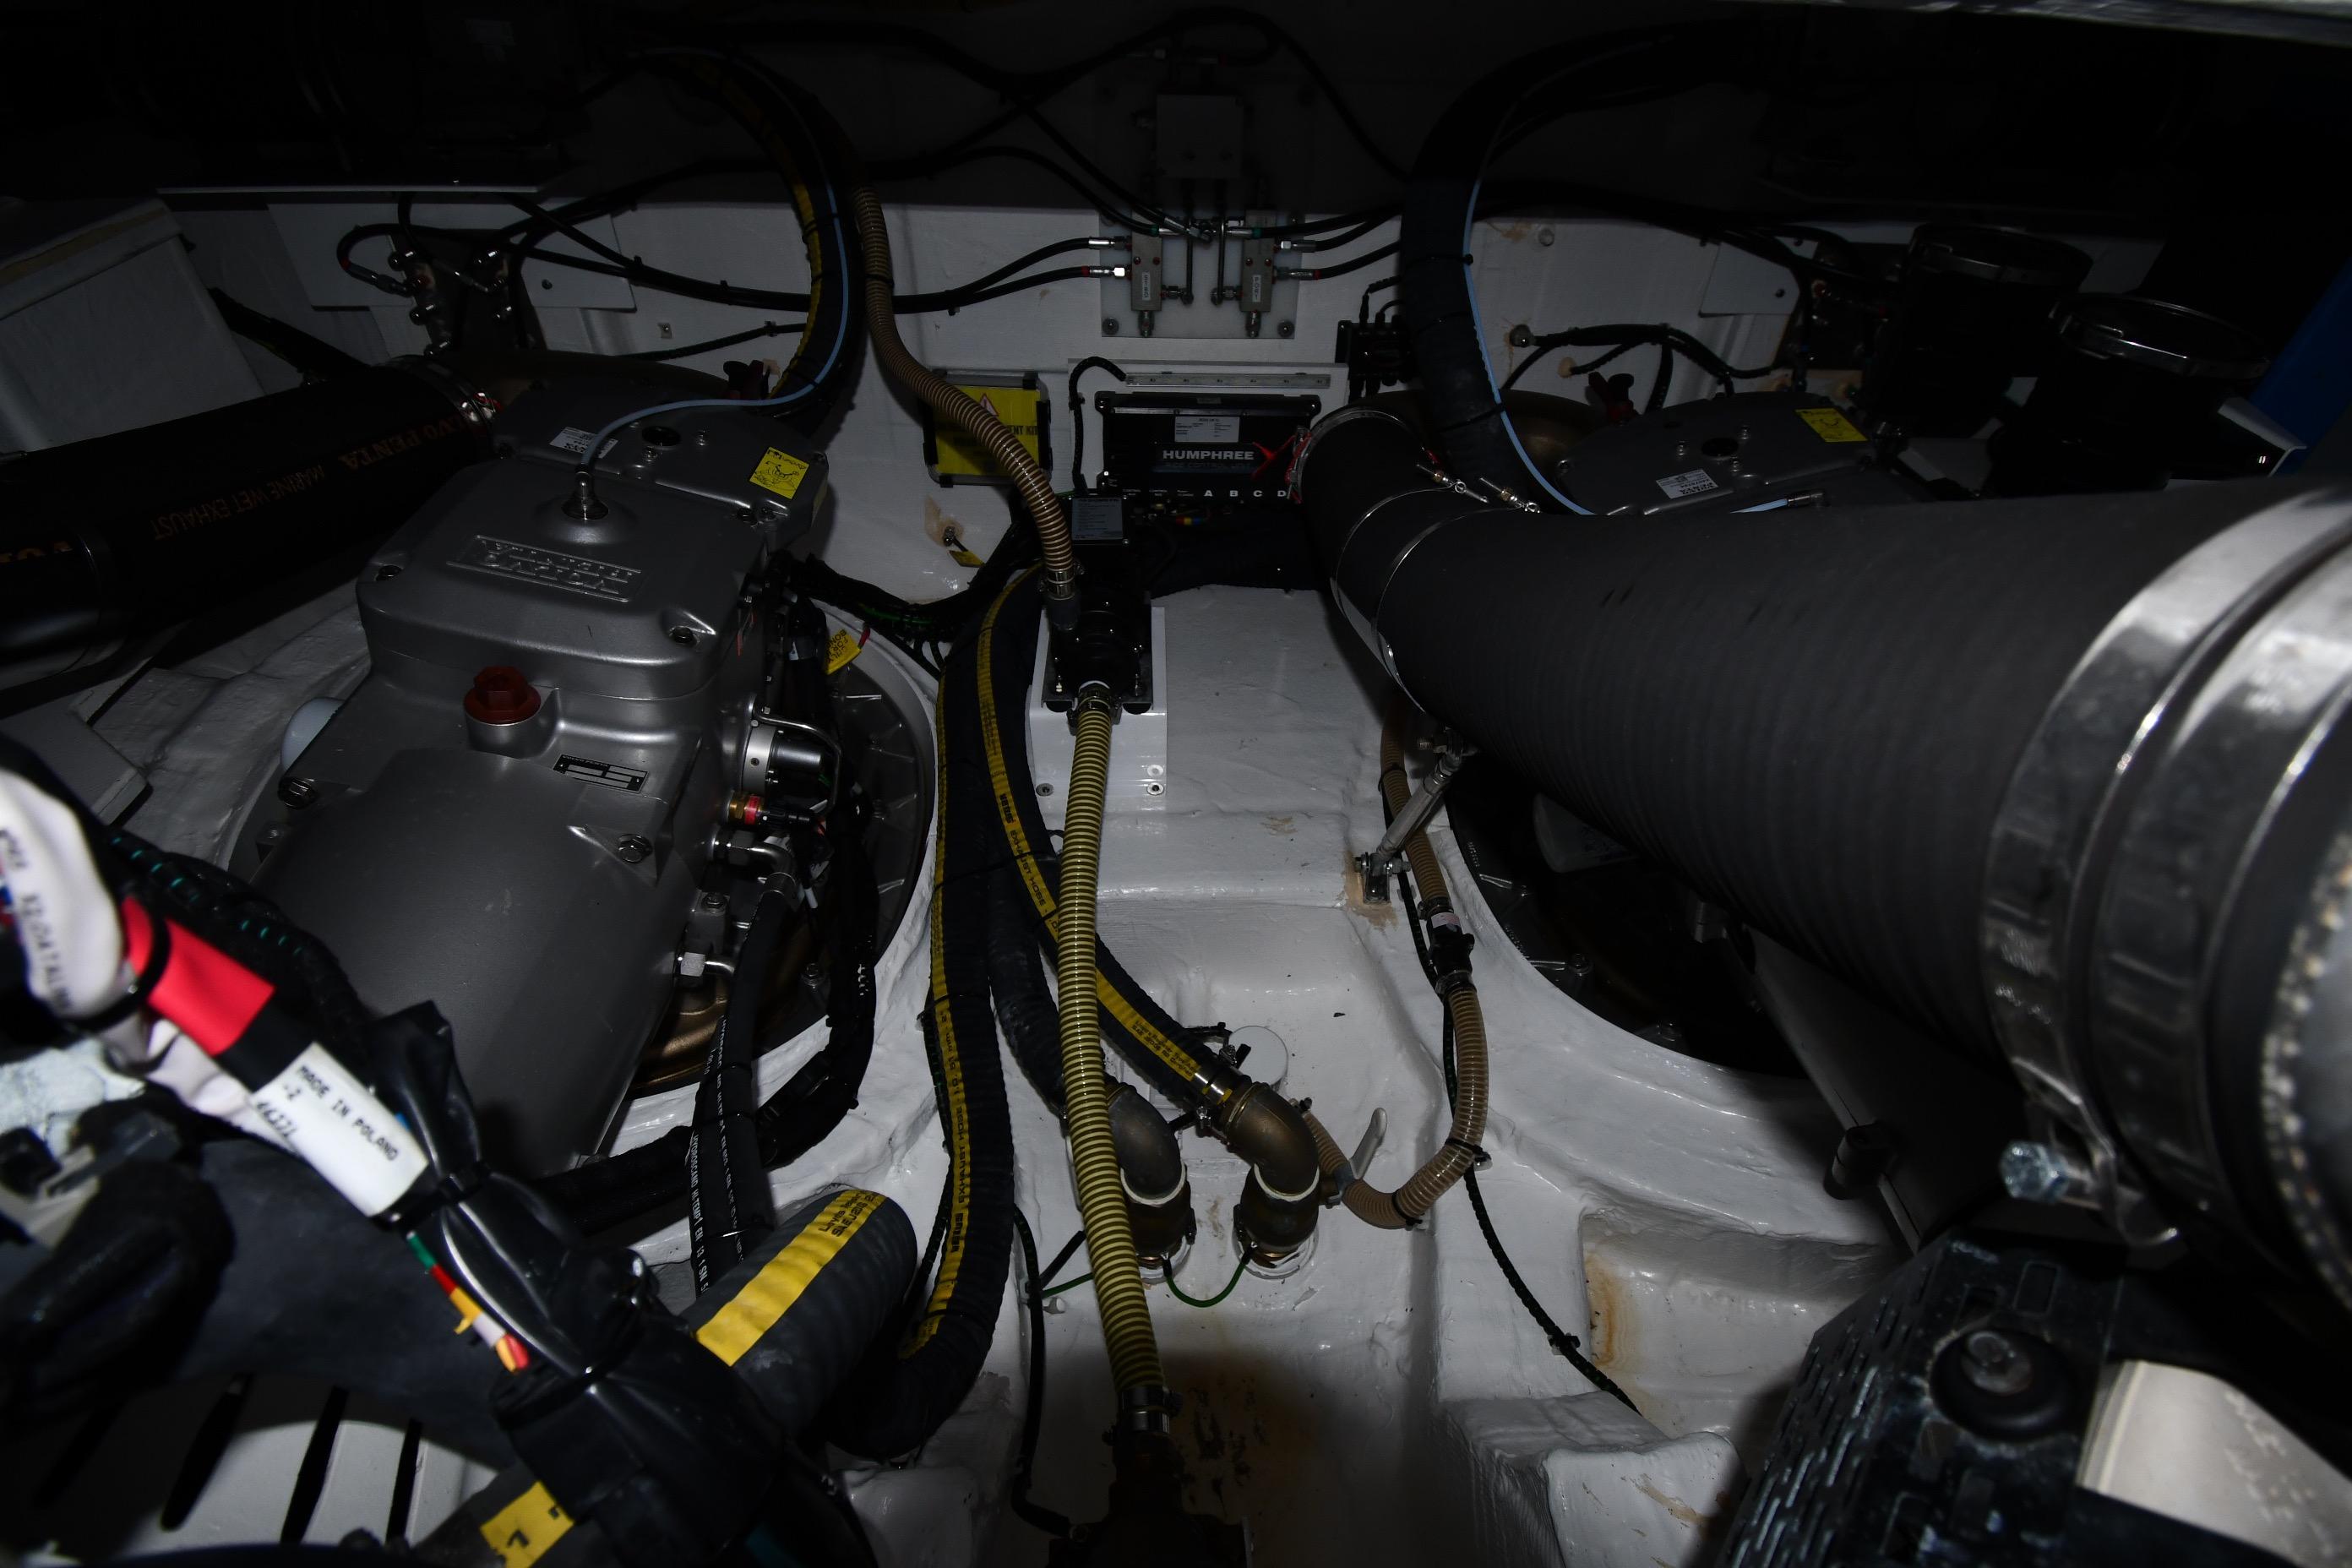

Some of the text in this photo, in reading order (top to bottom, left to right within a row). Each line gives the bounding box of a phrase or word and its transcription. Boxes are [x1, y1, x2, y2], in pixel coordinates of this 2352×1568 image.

[338, 427, 420, 472] PENTA
[1162, 449, 1255, 460] HUMPHREE
[153, 463, 325, 542] MARINE WET EXHAUST
[1203, 489, 1214, 498] A
[1229, 489, 1239, 498] B
[1252, 489, 1264, 498] C
[1277, 489, 1288, 498] D
[1029, 878, 1046, 906] HOSE
[945, 1033, 954, 1054] mm
[299, 1066, 399, 1162] MADE IN POLAND
[690, 1134, 700, 1188] HYDROSCAND
[958, 1146, 966, 1204] EXHAUST
[694, 1226, 704, 1243] EN
